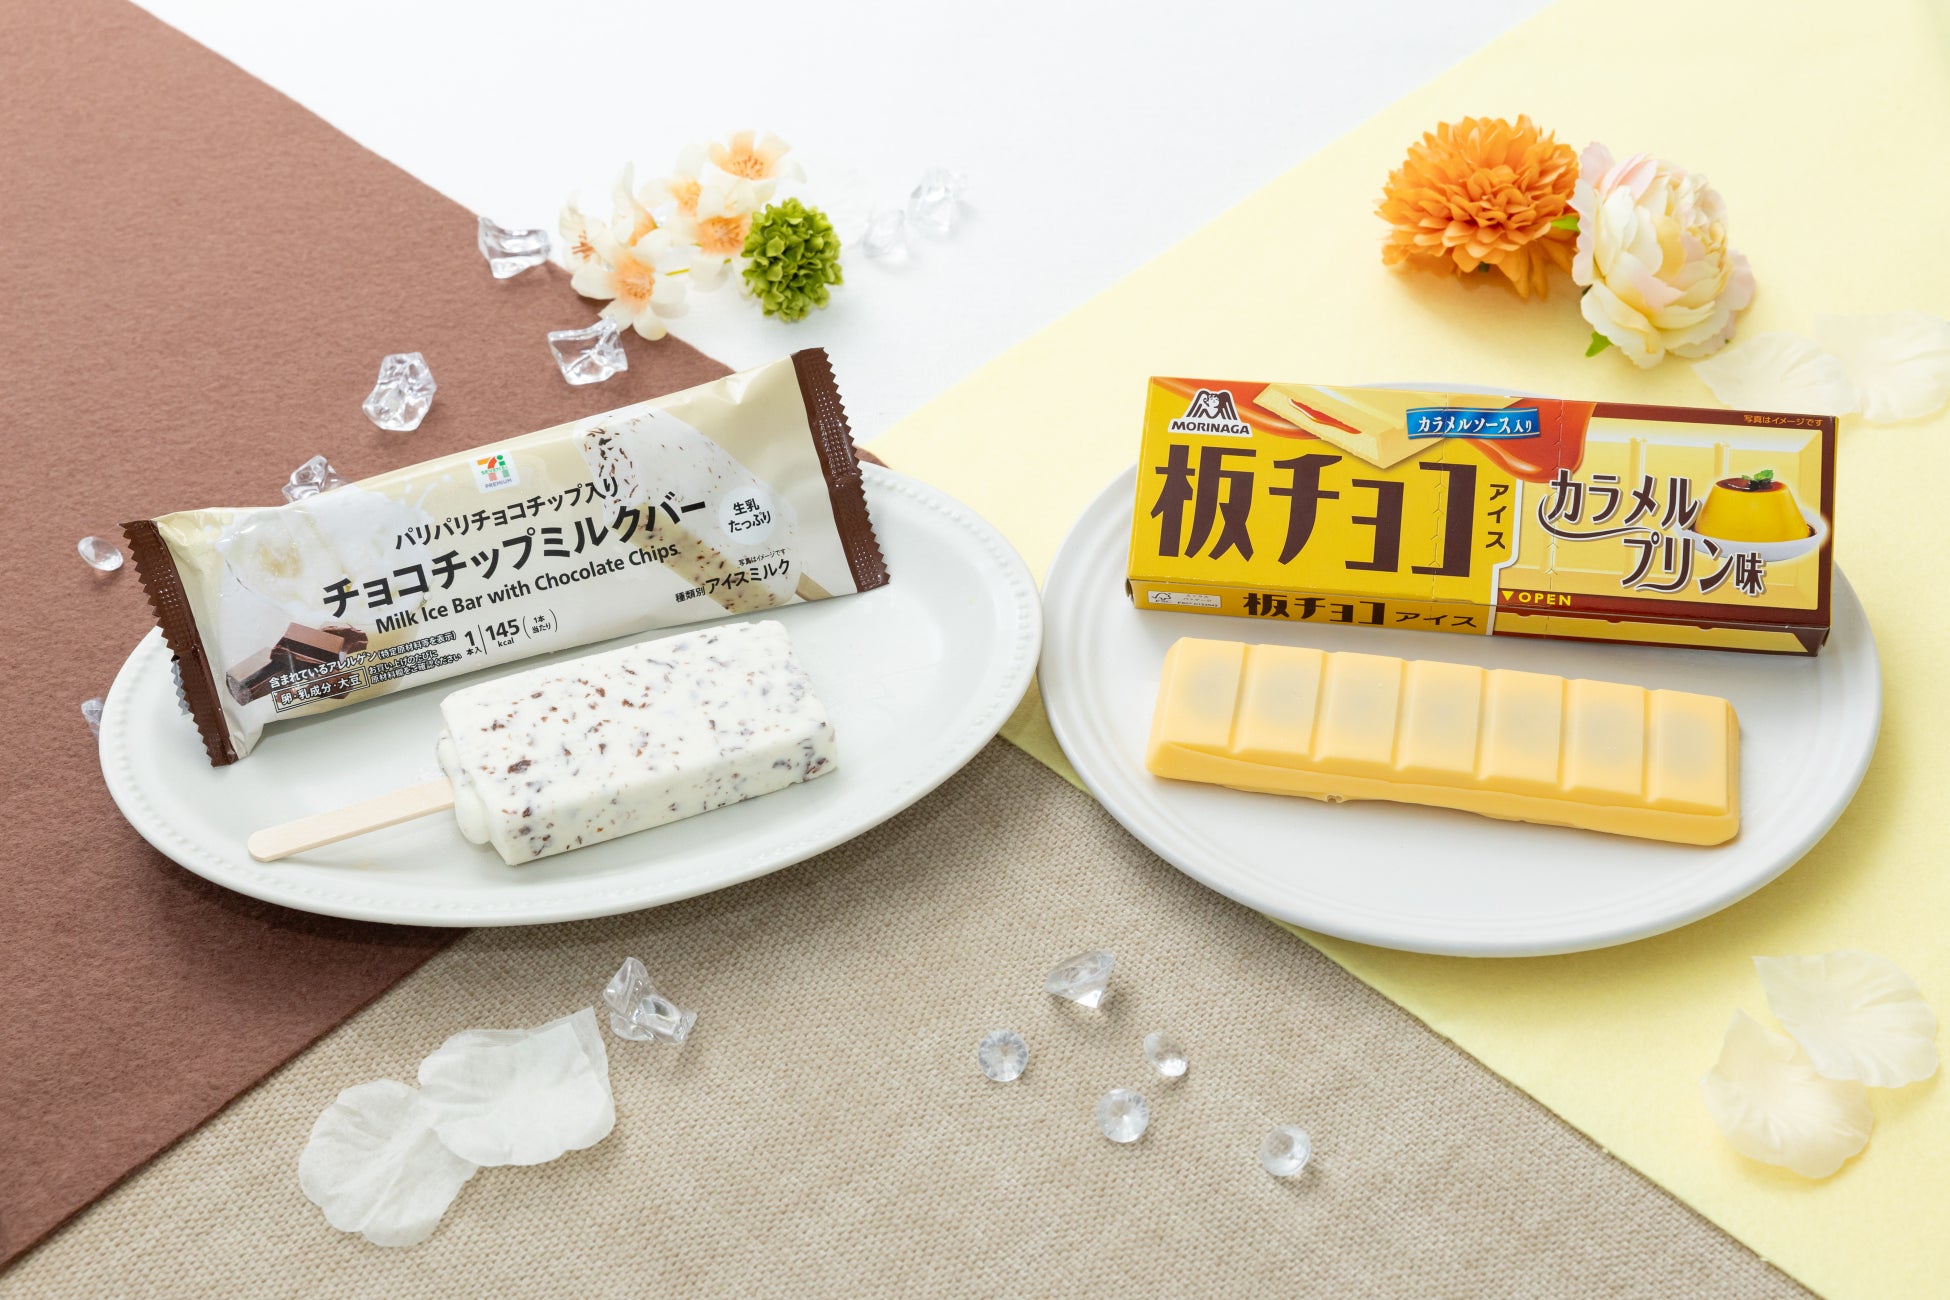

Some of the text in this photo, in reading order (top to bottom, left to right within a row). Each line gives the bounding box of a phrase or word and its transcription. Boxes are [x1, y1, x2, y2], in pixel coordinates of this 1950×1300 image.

[1171, 421, 1250, 434] MORINAGA
[1417, 416, 1532, 434] カラメルソース入り
[1743, 414, 1824, 427] 写真はイメージです
[395, 477, 618, 551] パリパリチョコチップ入り
[733, 498, 760, 516] 生乳
[1150, 443, 1477, 578] 板チョコ
[1485, 483, 1509, 550] アイス
[1539, 469, 1700, 539] カラメル
[728, 511, 771, 533] たっぷり
[322, 491, 706, 619] チョコチップミルクバー
[1620, 532, 1765, 595] プリン味
[375, 541, 679, 634] Milk Ice Bar with Chocolate Chips
[1518, 592, 1572, 606] OPEN
[1243, 592, 1386, 626] 板チョコ
[1396, 611, 1477, 628] アイス
[485, 618, 520, 641] 145
[497, 637, 515, 647] kcal
